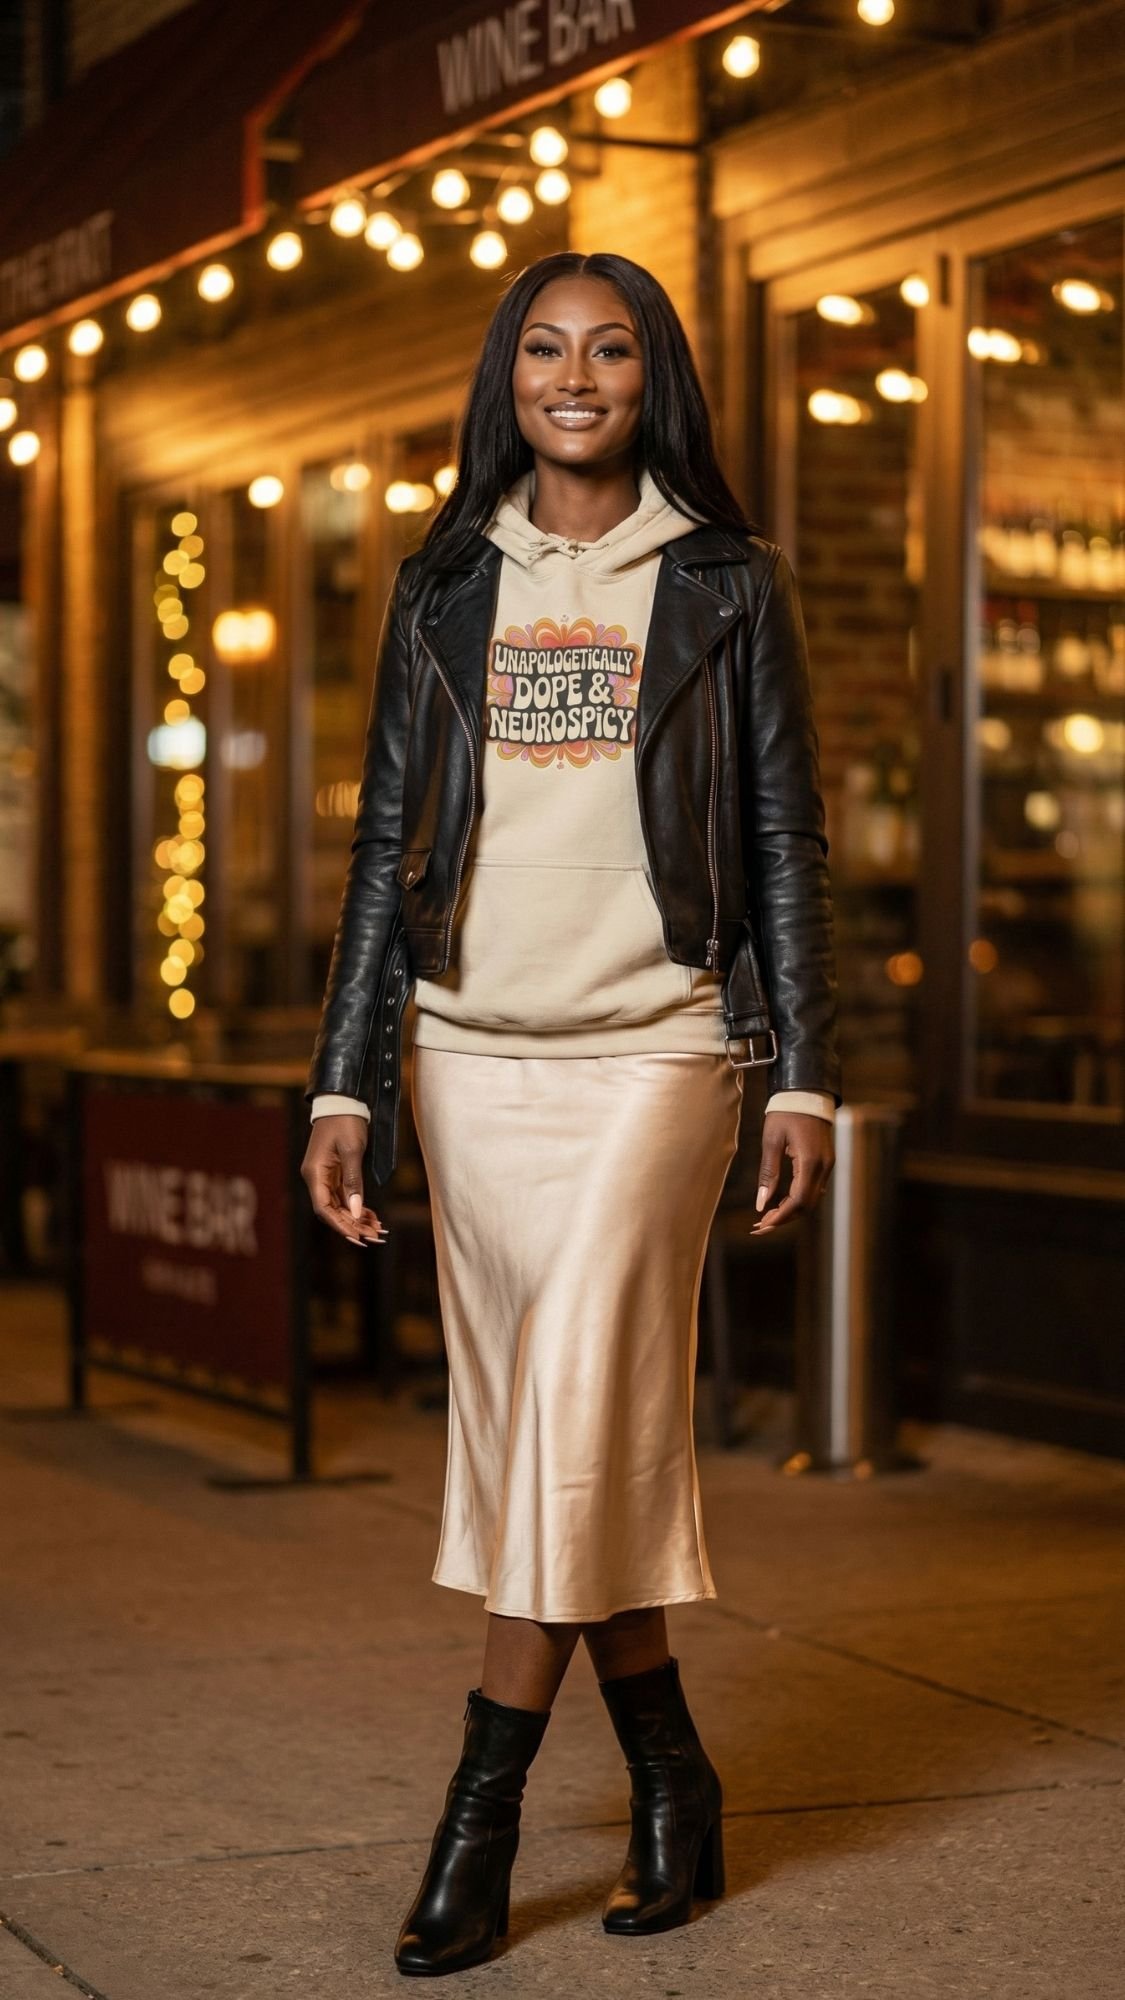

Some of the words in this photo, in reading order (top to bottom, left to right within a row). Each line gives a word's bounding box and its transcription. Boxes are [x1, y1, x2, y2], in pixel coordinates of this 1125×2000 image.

[438, 0, 544, 113] WINE
[513, 673, 583, 710] DOPE
[588, 672, 612, 704] &
[187, 1168, 258, 1255] BAR
